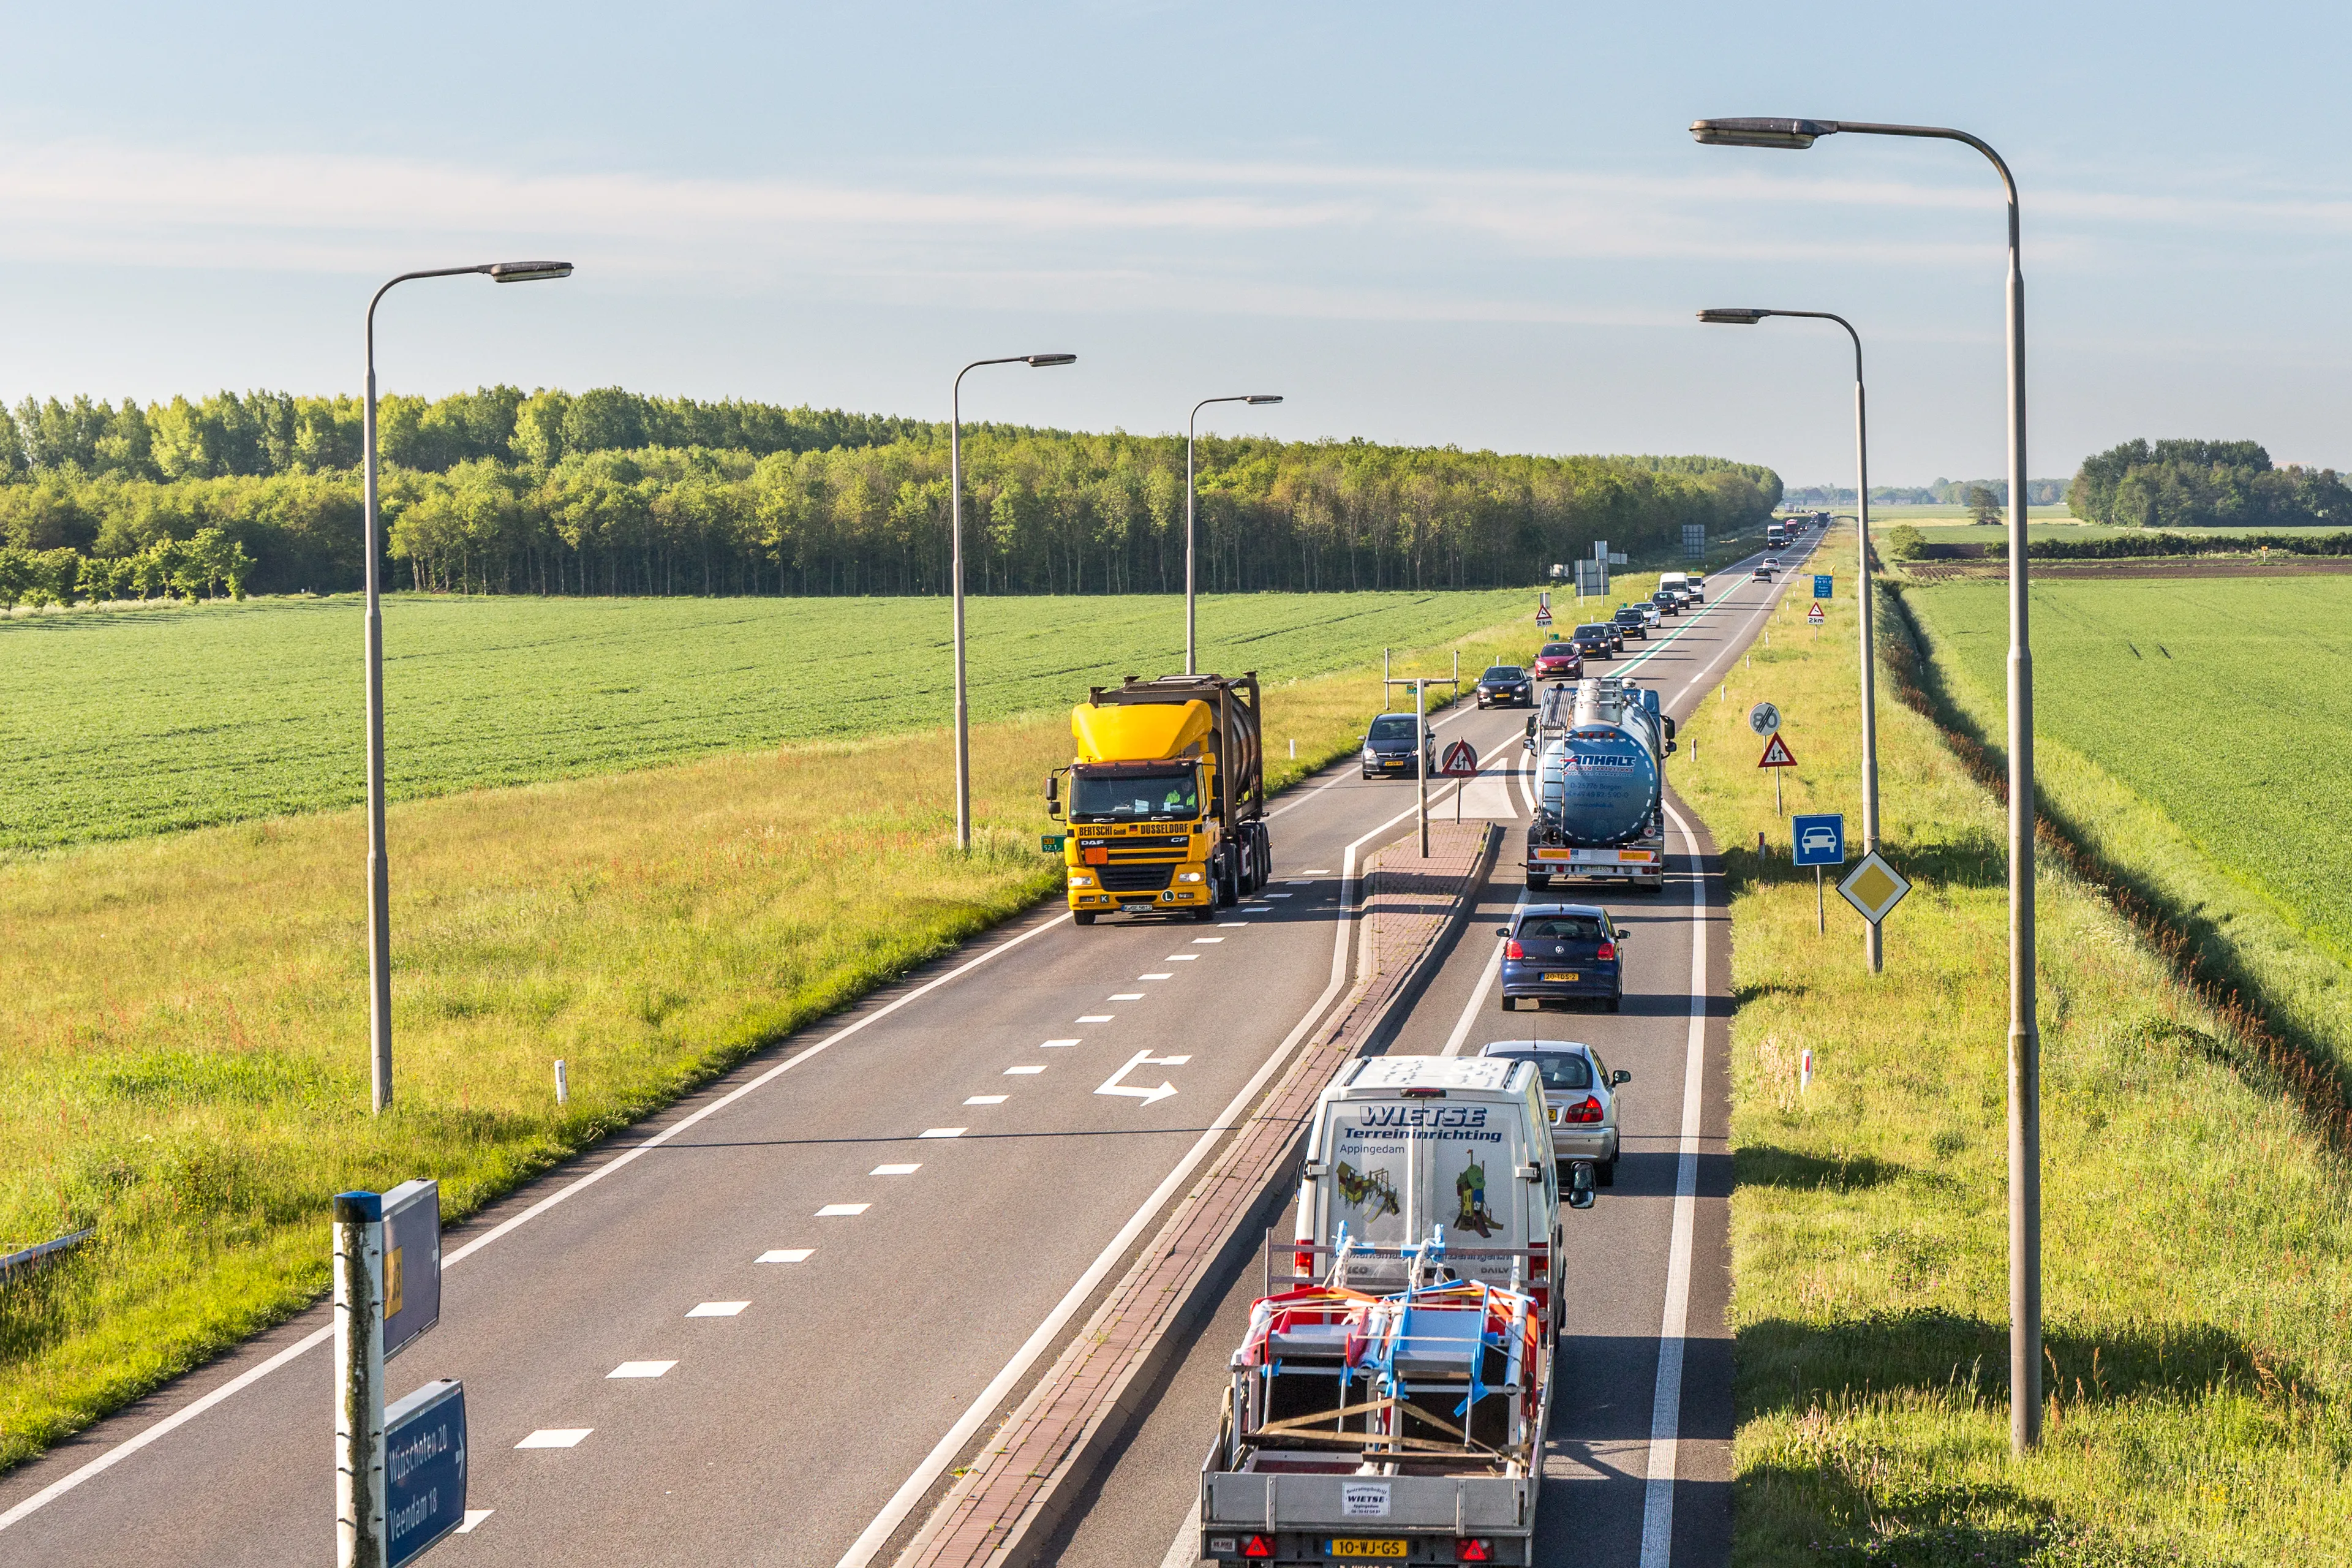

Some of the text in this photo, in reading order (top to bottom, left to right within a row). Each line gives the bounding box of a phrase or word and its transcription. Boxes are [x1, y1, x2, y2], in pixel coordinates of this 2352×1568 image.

[1753, 713, 1777, 728] 80
[1079, 826, 1112, 835] BERTSCHI
[1360, 1106, 1487, 1127] WIETSE
[1344, 1128, 1502, 1142] Terreininrichting
[1340, 1144, 1404, 1155] Appingedam
[389, 1424, 447, 1484] Winschoten 20
[390, 1487, 437, 1542] Veendam 18
[1340, 1542, 1400, 1554] 10-WJ-GS
